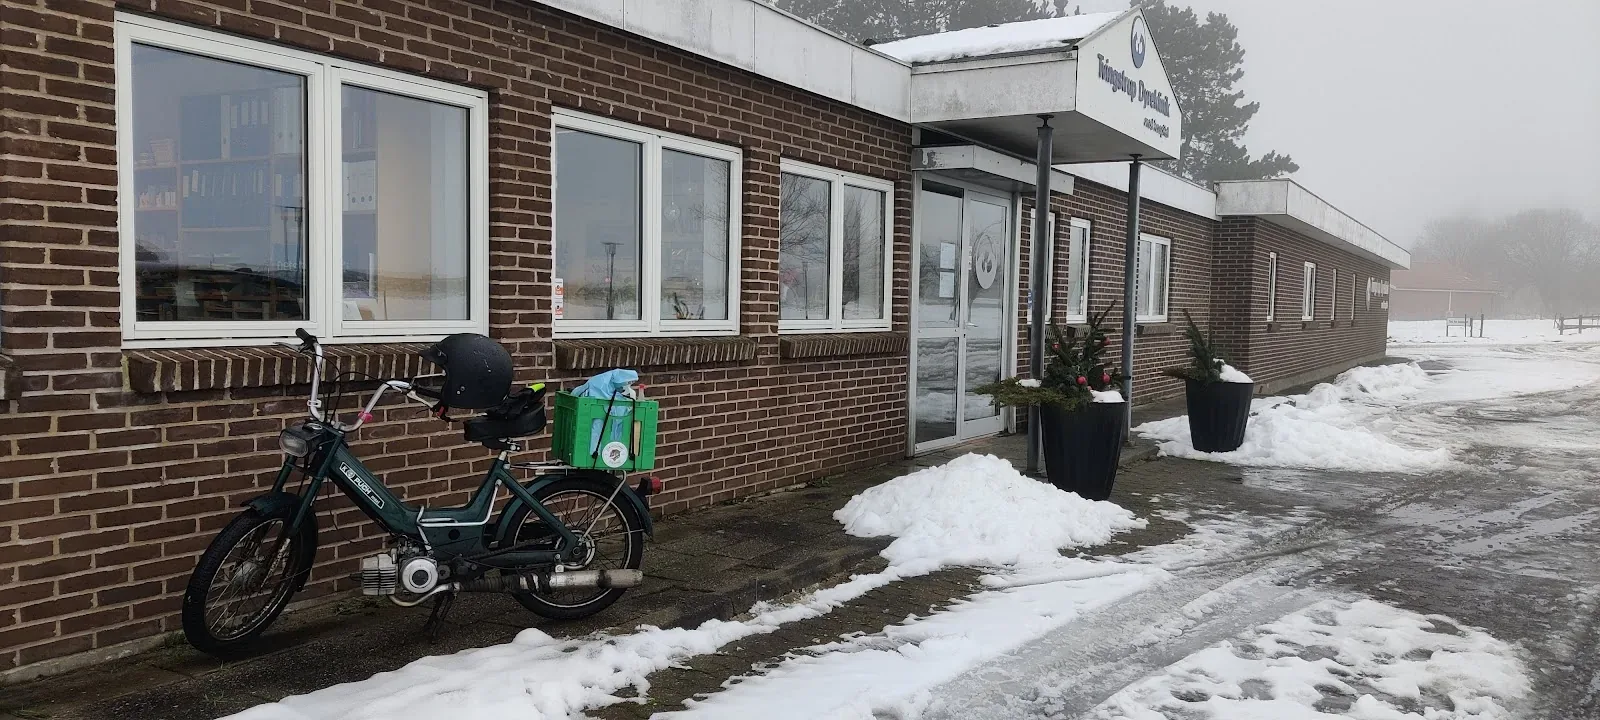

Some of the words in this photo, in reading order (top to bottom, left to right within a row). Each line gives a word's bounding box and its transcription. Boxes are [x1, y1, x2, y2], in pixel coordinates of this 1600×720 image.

[1097, 53, 1137, 102] Tvingstrup
[1138, 79, 1170, 117] Dyreklinik
[354, 477, 372, 494] PUCH
